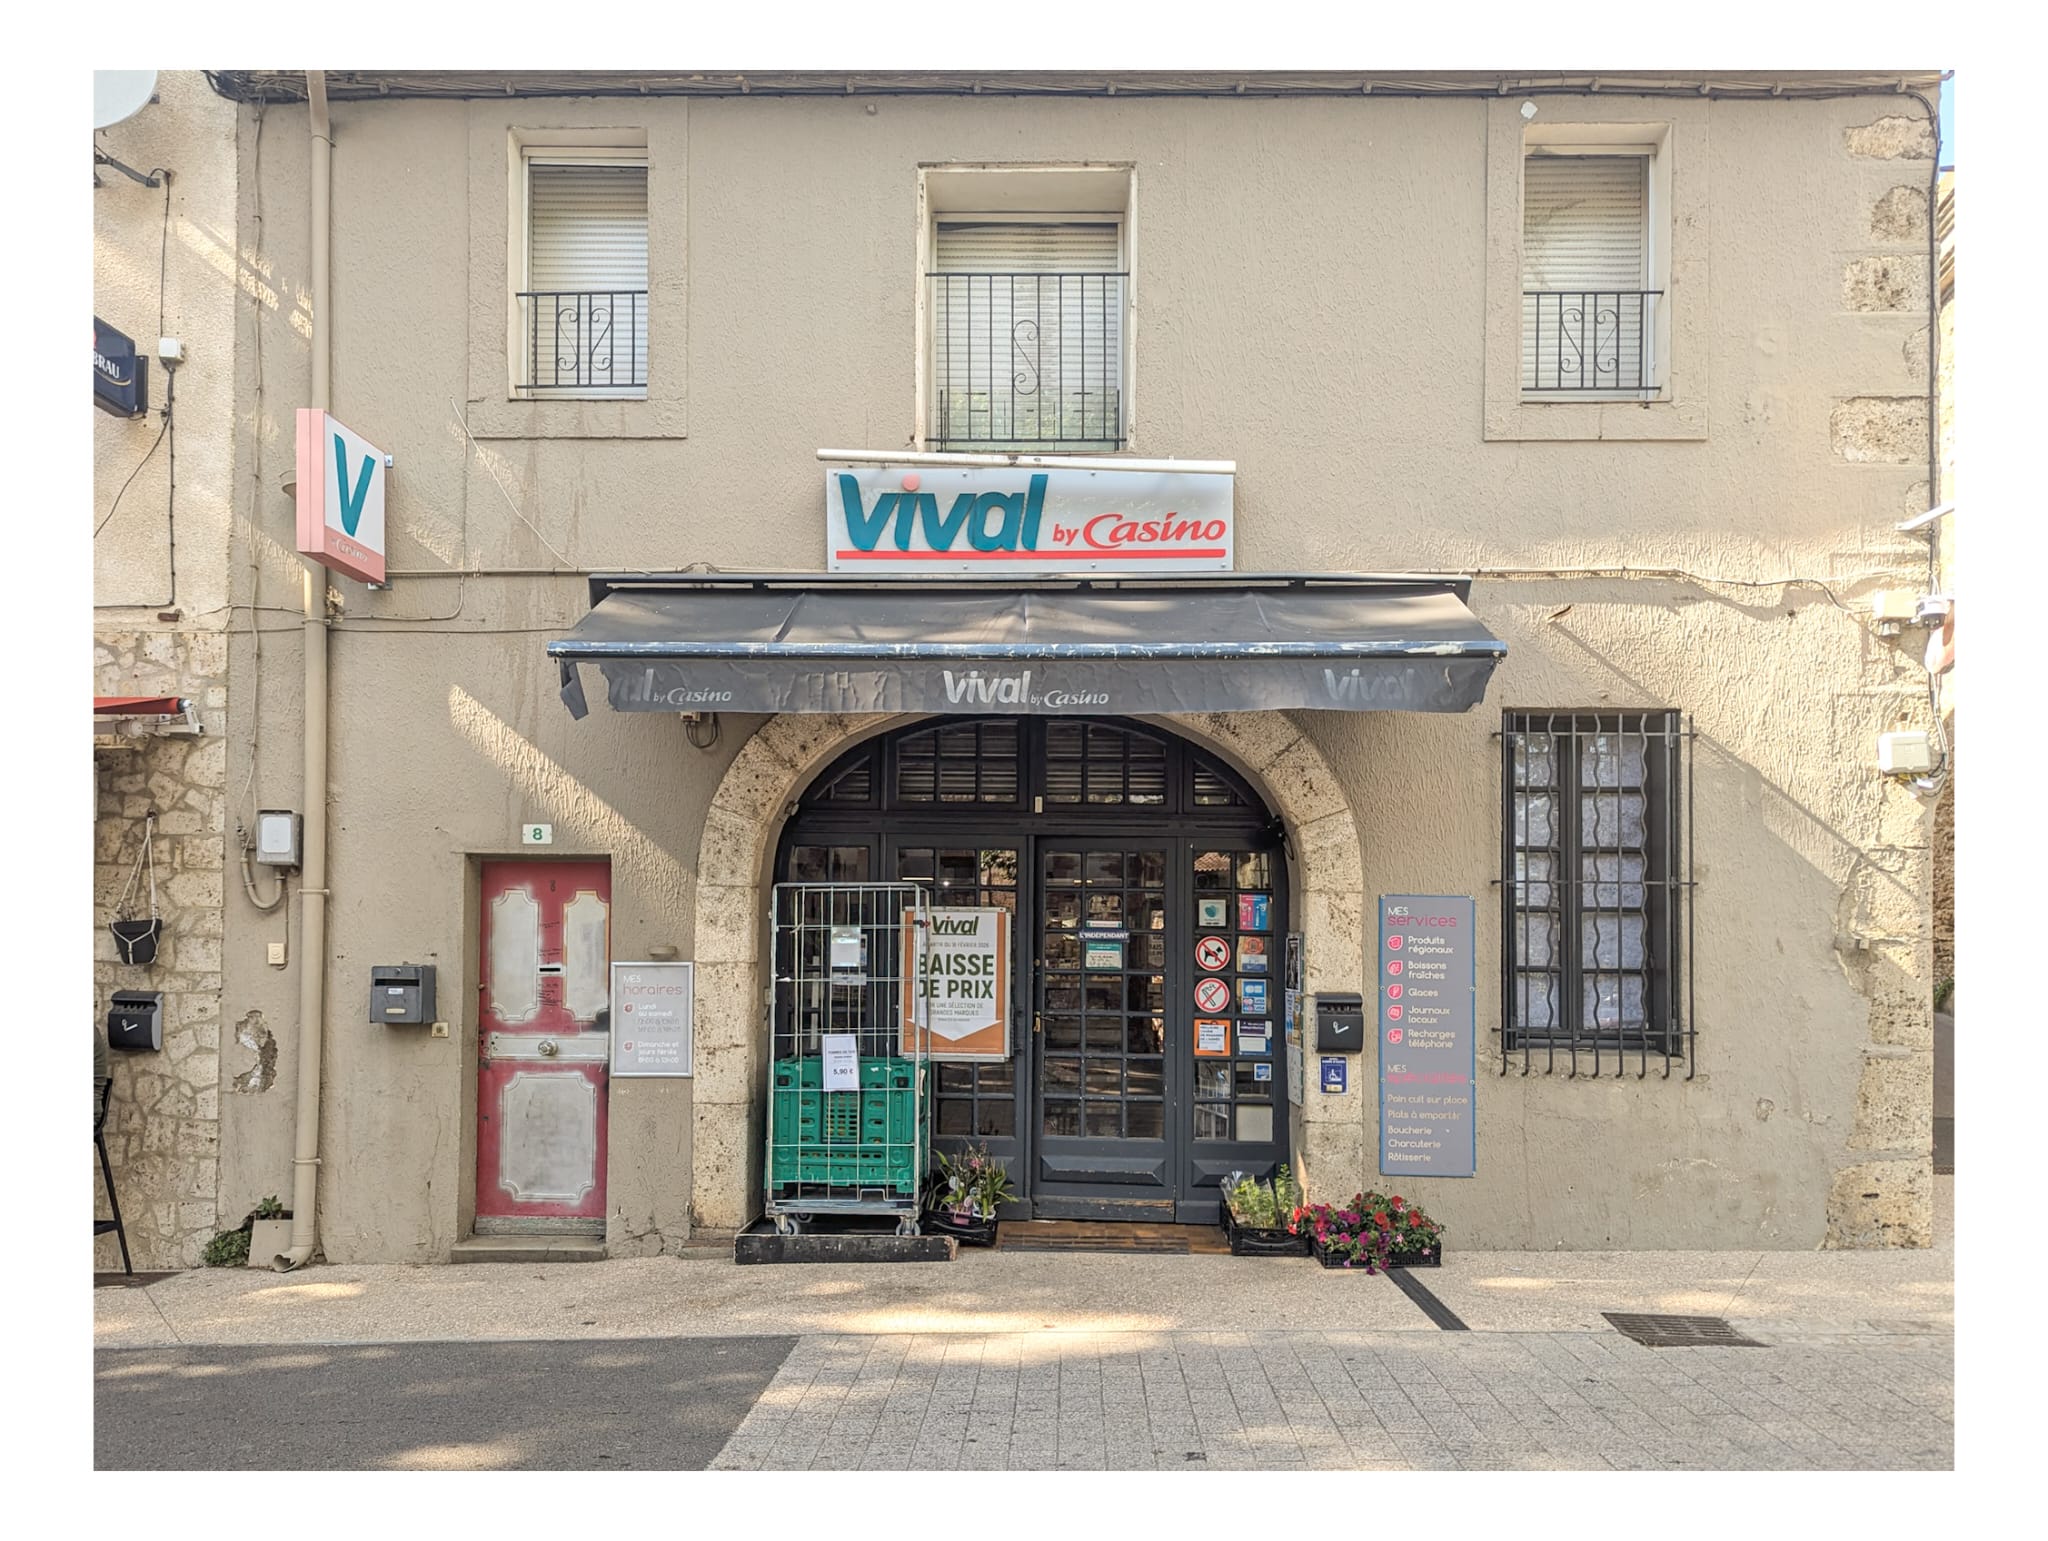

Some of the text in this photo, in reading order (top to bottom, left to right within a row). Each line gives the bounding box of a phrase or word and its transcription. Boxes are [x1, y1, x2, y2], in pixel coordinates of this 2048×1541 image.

[334, 432, 376, 537] V
[838, 473, 1226, 552] Vival by Casino
[943, 670, 1109, 708] Vival by Casino
[1324, 668, 1415, 700] Vival
[653, 693, 665, 703] by
[667, 688, 732, 704] Casino
[532, 828, 543, 841] 8
[1388, 906, 1409, 915] MES
[931, 915, 979, 934] Vival
[1387, 915, 1457, 927] services
[1408, 935, 1446, 944] Produits
[1408, 945, 1454, 955] régionaux
[919, 953, 994, 976] BAISSE
[1408, 961, 1447, 970] Boissons
[623, 975, 641, 983] MES
[1408, 971, 1445, 980] fraîches
[623, 984, 683, 996] horaires
[947, 979, 994, 999] PRIX
[1408, 988, 1439, 997] Glaces
[1408, 1005, 1450, 1014] Journaux
[1408, 1015, 1437, 1023] locaux
[1408, 1029, 1456, 1040] Recharges
[1408, 1040, 1453, 1050] téléphone
[1387, 1064, 1407, 1073] MES
[1387, 1094, 1406, 1103] Pain
[1408, 1095, 1424, 1104] cuit
[1443, 1096, 1468, 1105] place
[1388, 1125, 1432, 1135] Boucherie
[1388, 1139, 1441, 1148] Charcuterie
[1388, 1152, 1431, 1161] Rôtisserie
